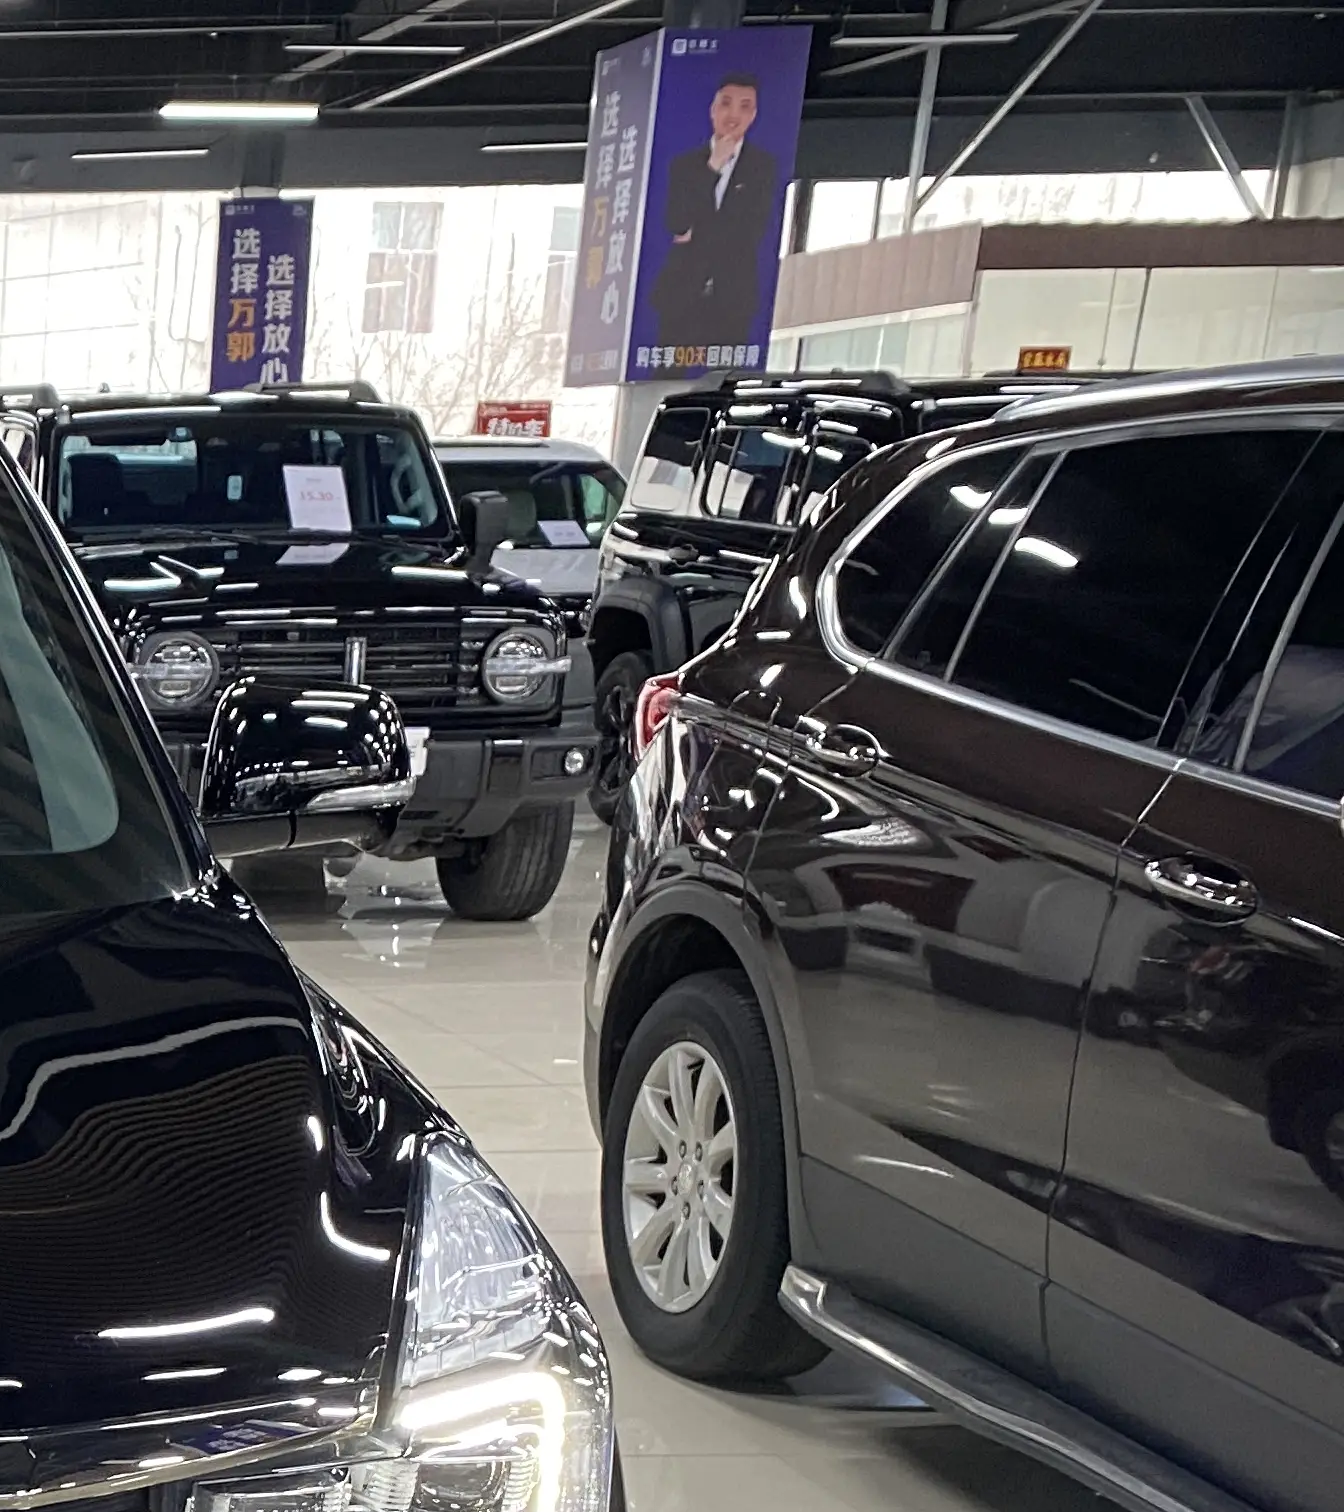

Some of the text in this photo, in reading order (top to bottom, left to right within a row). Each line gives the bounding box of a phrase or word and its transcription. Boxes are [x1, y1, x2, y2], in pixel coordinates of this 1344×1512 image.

[225, 227, 261, 363] 选择万郭
[261, 253, 296, 385] 选择放心
